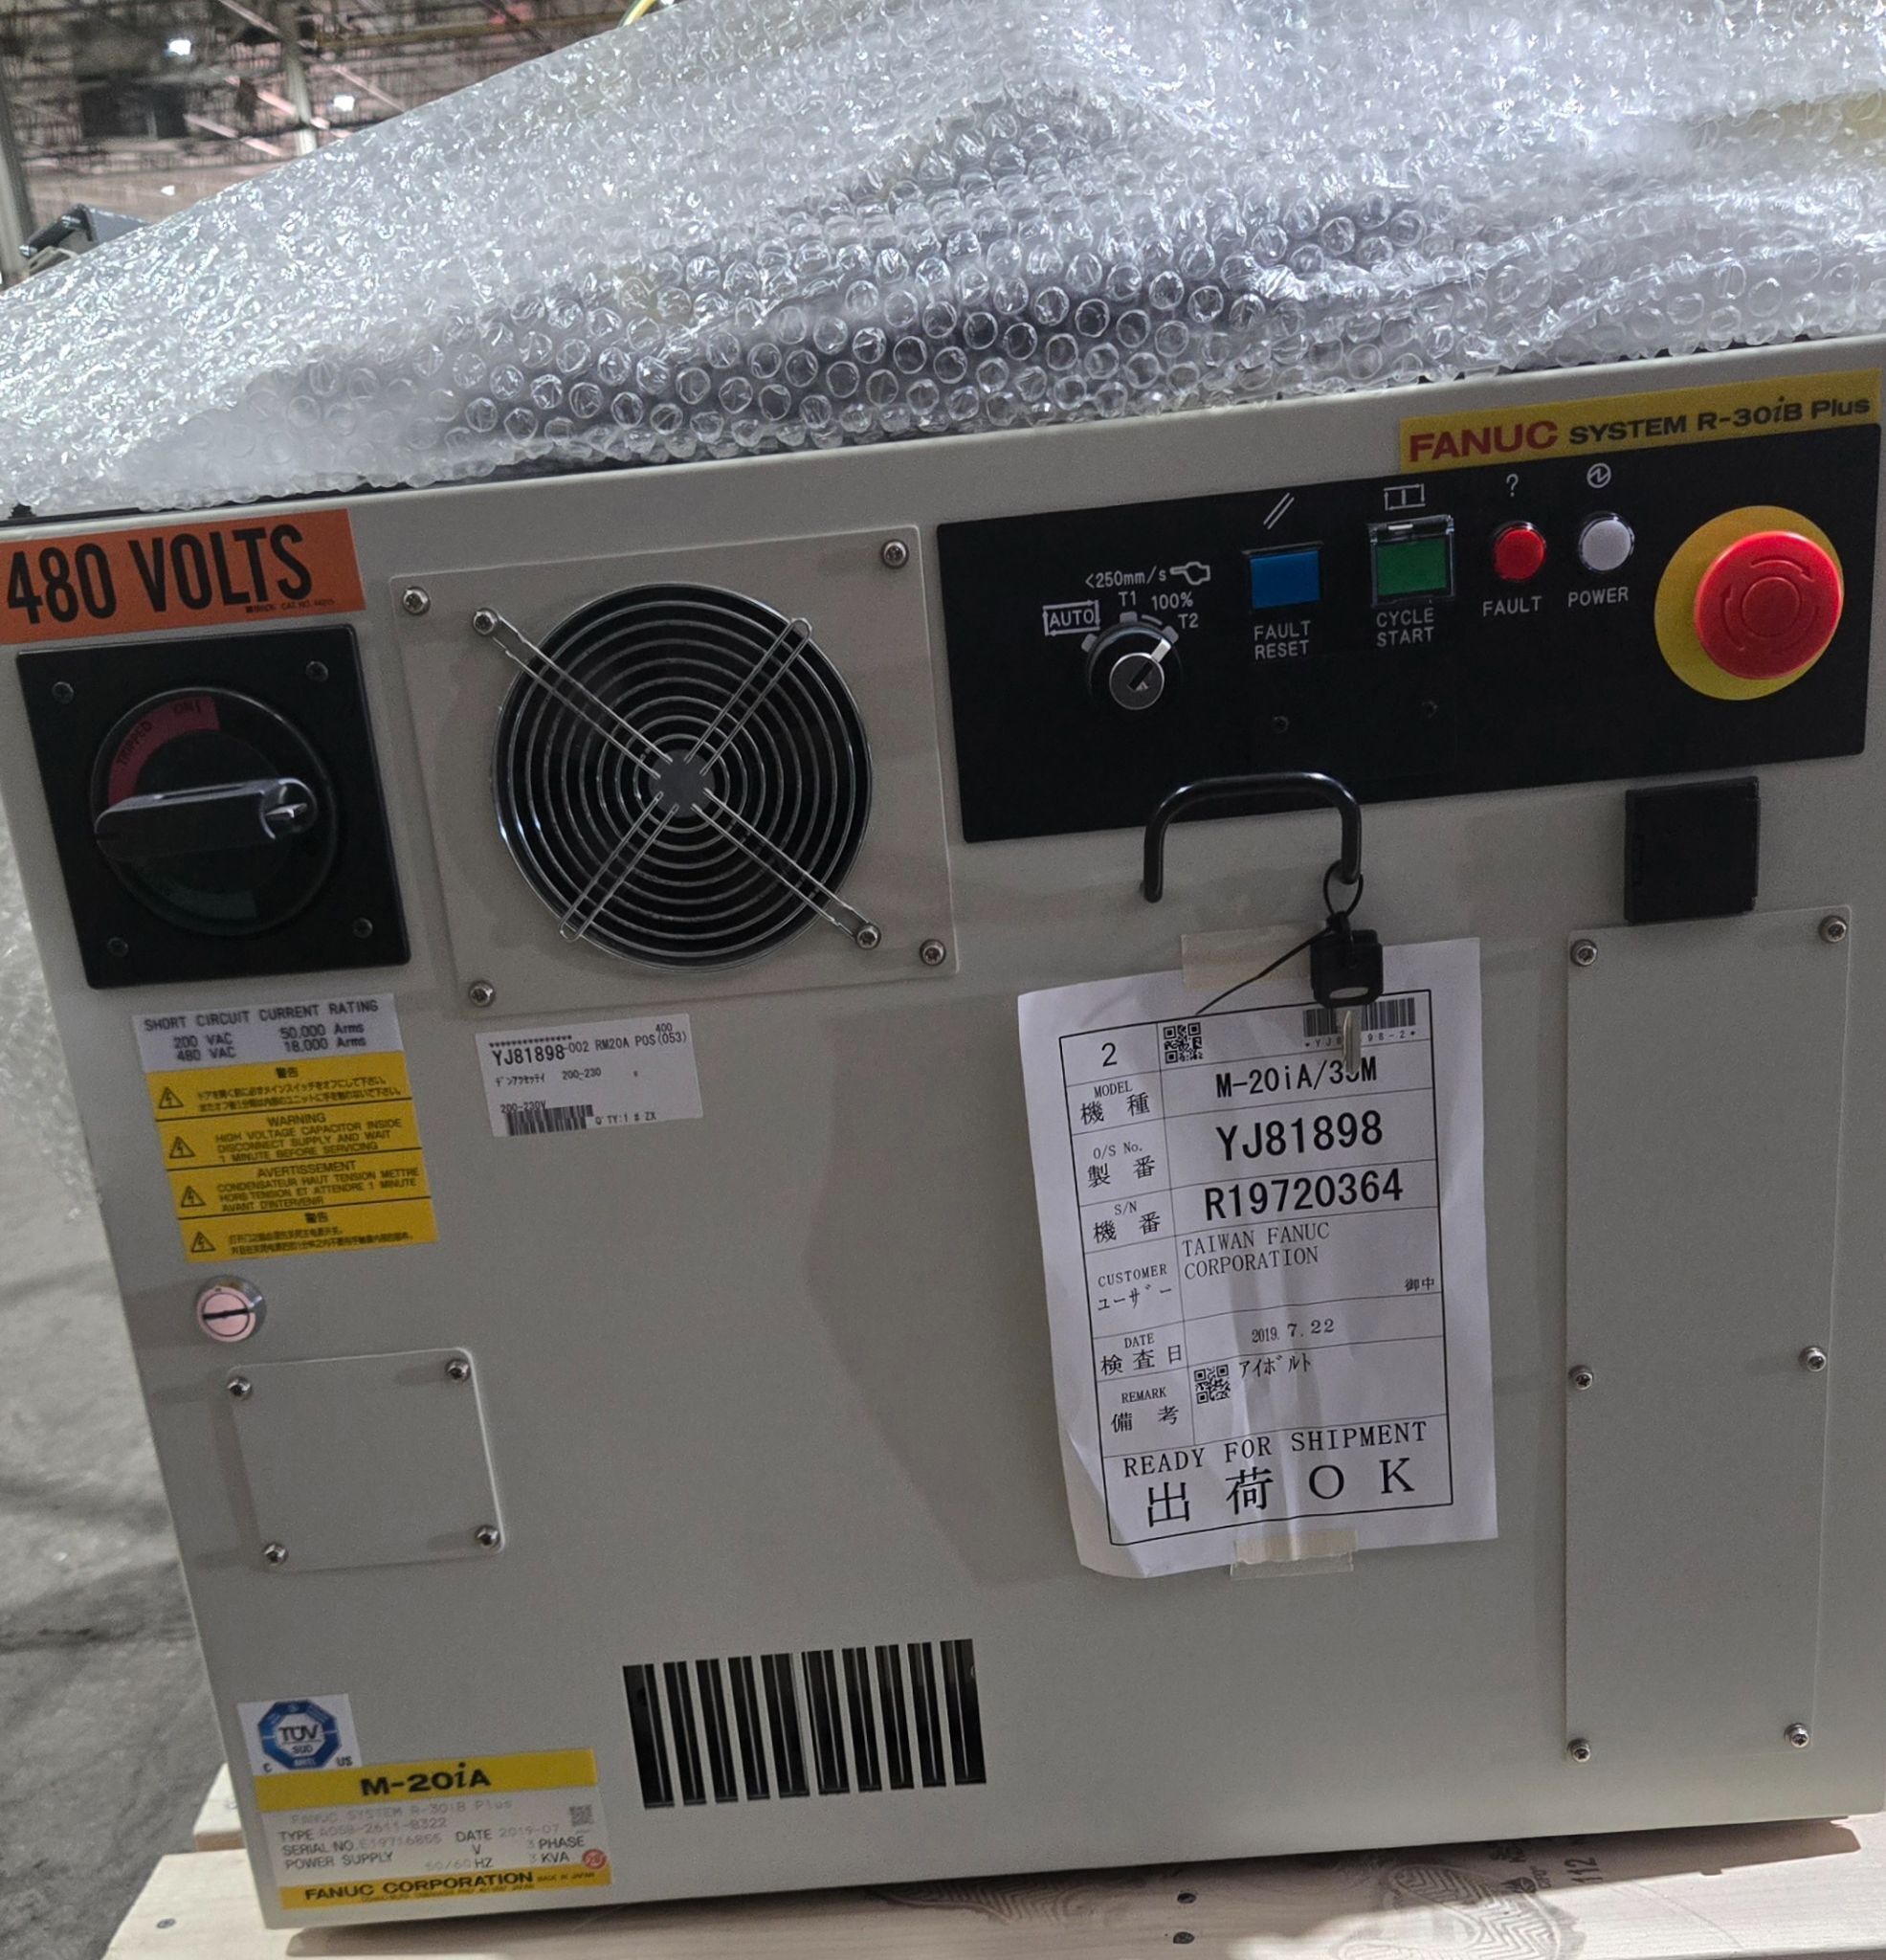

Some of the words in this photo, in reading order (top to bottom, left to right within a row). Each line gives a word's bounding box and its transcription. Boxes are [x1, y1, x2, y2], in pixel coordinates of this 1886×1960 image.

[1409, 421, 1559, 462] FANUC
[1569, 415, 1686, 444] SYSTEM
[1697, 396, 1802, 430] R-30iB
[1811, 398, 1870, 418] Plus
[8, 543, 117, 624] 480
[128, 524, 312, 612] VOLTS
[1085, 566, 1166, 589] <250mm/s
[1118, 590, 1137, 607] T1
[1151, 591, 1194, 611] 100%
[1482, 596, 1542, 617] FAULT
[1567, 587, 1629, 608] POWER
[1049, 610, 1095, 628] AUTO
[1178, 612, 1199, 629] T2
[1376, 607, 1434, 628] CYCLE
[1254, 620, 1311, 640] FAULT
[1377, 627, 1434, 648] START
[1254, 639, 1310, 660] RESET
[144, 1015, 187, 1032] SHORT
[196, 1011, 250, 1027] CIRCUIT
[259, 1006, 319, 1022] CURRENT
[329, 1000, 379, 1015] RATING
[173, 1036, 198, 1049] 200
[207, 1033, 233, 1047] VAC
[335, 1022, 365, 1035] Arms
[655, 1022, 673, 1034] 400
[177, 1048, 201, 1062] 480
[210, 1045, 236, 1059] VAC
[337, 1036, 366, 1048] Arms
[595, 1036, 630, 1051] RM20A
[635, 1031, 687, 1048] POS(053)
[1101, 1042, 1117, 1067] 2
[1094, 1080, 1133, 1099] MODEL
[267, 1112, 326, 1127] WARNING
[215, 1132, 241, 1143] HIGH
[247, 1127, 296, 1140] VOLTAGE
[300, 1122, 362, 1136] CAPACITOR
[367, 1118, 402, 1129] INSIDE
[1216, 1110, 1384, 1162] YJ81898
[217, 1139, 284, 1154] DISCONNECT
[290, 1134, 331, 1147] SUPPLY
[337, 1131, 359, 1143] AND
[365, 1129, 391, 1140] WAIT
[1093, 1144, 1117, 1160] O/S
[1123, 1142, 1143, 1155] No.
[232, 1150, 270, 1162] MINUTE
[277, 1146, 318, 1158] BEFORE
[323, 1142, 379, 1155] SERVICING
[257, 1160, 356, 1178] AVERTISSEMENT
[217, 1178, 297, 1192] CONDENSATEUR
[302, 1173, 328, 1185] HAUT
[335, 1169, 376, 1182] TENSION
[381, 1167, 419, 1178] METTRE
[297, 1186, 307, 1195] ET
[314, 1182, 364, 1194] ATTENDRE
[381, 1178, 417, 1190] MINUTE
[1205, 1168, 1404, 1221] R19720364
[222, 1199, 255, 1213] AVANT
[1114, 1201, 1138, 1216] S/N
[1182, 1229, 1254, 1258] TAIWAN
[1268, 1222, 1330, 1246] FANUC
[1184, 1246, 1320, 1280] CORPORATION
[1098, 1263, 1167, 1288] CUSTOMER
[1405, 1277, 1435, 1292] 御中
[1123, 1332, 1155, 1348] DATE
[1121, 1386, 1167, 1404] REMARK
[1124, 1447, 1206, 1478] READY
[1225, 1436, 1273, 1463] FOR
[1291, 1420, 1427, 1453] SHIPMENT
[278, 1724, 320, 1742] TÜV
[336, 1755, 353, 1768] US
[360, 1762, 491, 1797] M-20iA
[347, 1806, 403, 1821] SYSTEM
[475, 1799, 513, 1812] Plus
[279, 1830, 314, 1841] TYPE
[455, 1829, 493, 1842] DATE
[539, 1836, 585, 1849] PHASE
[282, 1844, 330, 1857] SERIAL
[472, 1843, 482, 1855] V
[541, 1851, 570, 1864] KVA
[285, 1856, 334, 1870] POWER
[343, 1852, 393, 1865] SUPPLY
[475, 1857, 493, 1869] HZ
[304, 1883, 374, 1901] FANUC
[383, 1872, 534, 1894] CORPORATION
